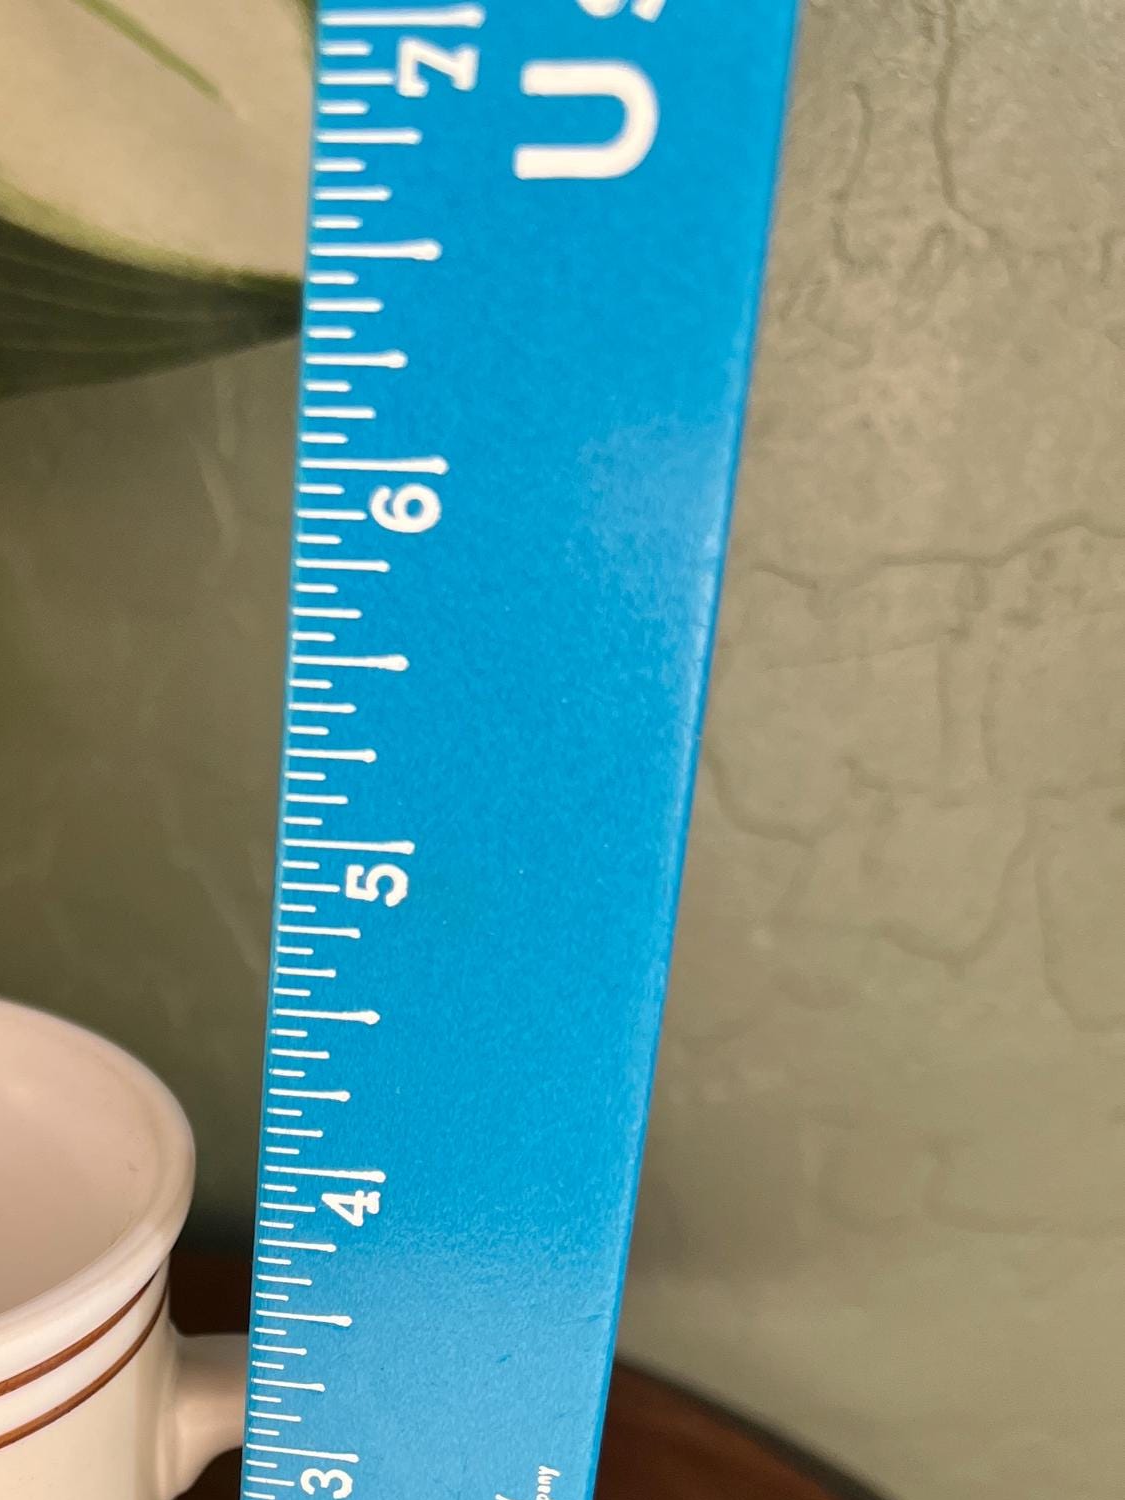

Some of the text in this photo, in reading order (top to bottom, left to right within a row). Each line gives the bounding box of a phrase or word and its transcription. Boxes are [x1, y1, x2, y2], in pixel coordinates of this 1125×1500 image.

[395, 37, 481, 98] 7
[513, 0, 665, 180] U
[370, 484, 440, 533] 6
[345, 864, 409, 907] 5
[322, 1190, 381, 1226] 4
[300, 1466, 354, 1500] 3
